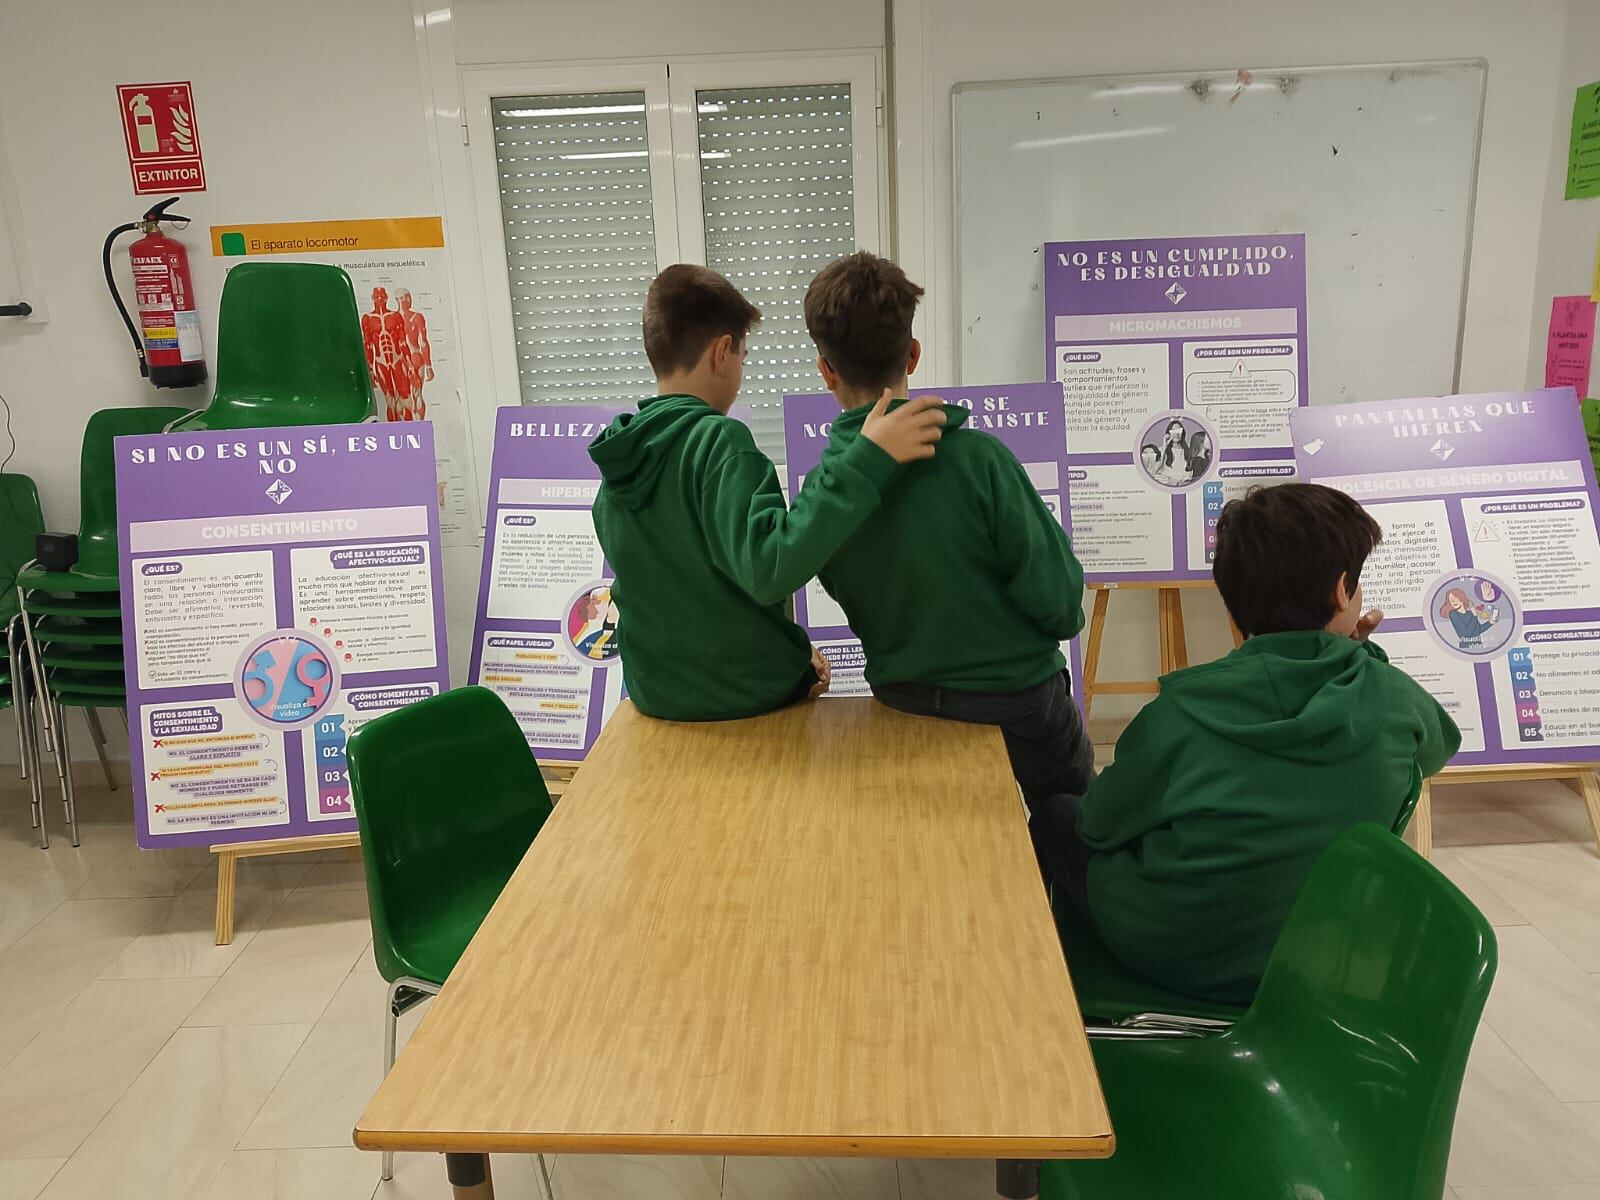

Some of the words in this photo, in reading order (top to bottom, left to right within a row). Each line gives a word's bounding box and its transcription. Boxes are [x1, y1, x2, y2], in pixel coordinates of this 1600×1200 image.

[139, 168, 198, 182] EXTINTOR
[251, 240, 261, 249] El
[264, 239, 303, 251] aparato
[306, 237, 358, 248] locomotor
[1057, 252, 1088, 267] NO
[1098, 251, 1122, 265] ES
[1131, 249, 1158, 264] UN
[1167, 245, 1294, 263] CUMPLIDO,
[387, 259, 425, 267] esquelética
[1081, 267, 1106, 281] ES
[1115, 262, 1272, 281] DESIGUALDAD
[1109, 317, 1242, 334] MICROMACHISMOS
[1066, 354, 1081, 362] ¿QUÉ
[1079, 367, 1115, 375] actitudes,
[1064, 375, 1128, 384] comportamientos
[984, 397, 1009, 411] SE
[1335, 405, 1476, 427] PANTALLAS
[1485, 400, 1536, 417] QUE
[968, 412, 1049, 429] EXISTE
[1393, 420, 1483, 438] HIEREN
[131, 448, 156, 464] SI
[167, 445, 205, 462] NO
[217, 442, 248, 459] ES
[258, 440, 291, 457] UN
[303, 434, 336, 456] SÍ,
[348, 436, 378, 452] ES
[388, 434, 421, 449] UN
[258, 458, 297, 475] NO
[1417, 475, 1437, 489] DE
[1440, 469, 1505, 487] GÉNERO
[1507, 469, 1569, 484] DIGITAL
[201, 518, 358, 540] CONSENTIMIENTO
[1405, 537, 1437, 545] digitales
[334, 550, 353, 561] ¿QUÉ
[376, 547, 419, 556] EDUCACIÓN
[348, 555, 420, 565] AFECTIVO-SEXUAL?
[144, 564, 164, 574] ¿QUÉ
[166, 564, 179, 572] ES?
[154, 576, 207, 585] consentimiento
[234, 572, 263, 580] acuerdo
[358, 570, 410, 579] afectivo-sexual
[203, 581, 238, 589] voluntario
[1386, 586, 1421, 594] personas
[183, 591, 215, 599] personas
[335, 587, 378, 595] herramienta
[300, 598, 331, 606] aprender
[358, 593, 396, 601] emociones,
[400, 592, 428, 600] respeto,
[300, 604, 334, 613] relaciones
[1528, 633, 1552, 641] ¿CÓMO
[489, 638, 506, 646] ¿QUÉ
[525, 639, 552, 647] JUEGAN?
[1513, 653, 1524, 661] 01
[1516, 672, 1528, 680] 02
[351, 693, 377, 702] ¿CÓMO
[379, 690, 419, 698] FOMENTAR
[1519, 690, 1531, 698] 03
[1522, 709, 1534, 717] 04
[154, 717, 219, 727] CONSENTIMIENTO
[172, 724, 218, 732] SEXUALIDAD
[321, 722, 335, 733] 01
[1524, 728, 1537, 736] 05
[323, 747, 338, 758] 02
[325, 771, 340, 782] 03
[326, 795, 342, 806] 04
